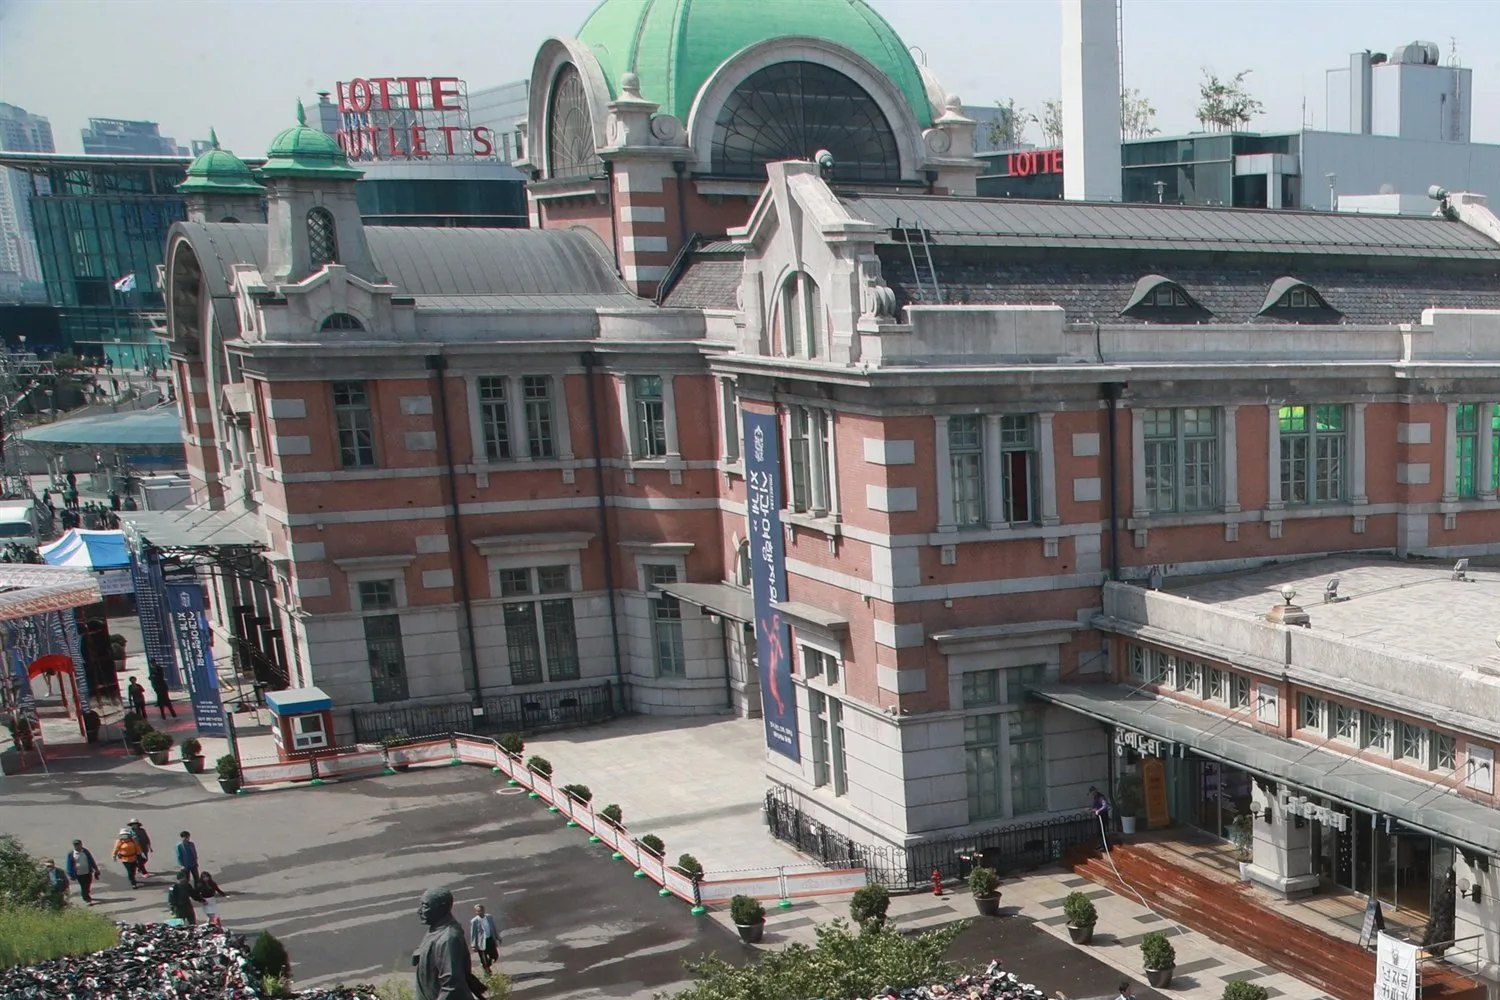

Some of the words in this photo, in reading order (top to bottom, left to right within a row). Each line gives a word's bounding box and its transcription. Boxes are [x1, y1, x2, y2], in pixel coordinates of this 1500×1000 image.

[336, 77, 462, 113] LOTTE
[336, 126, 493, 157] OUTLETS
[1008, 149, 1063, 177] LOTTE
